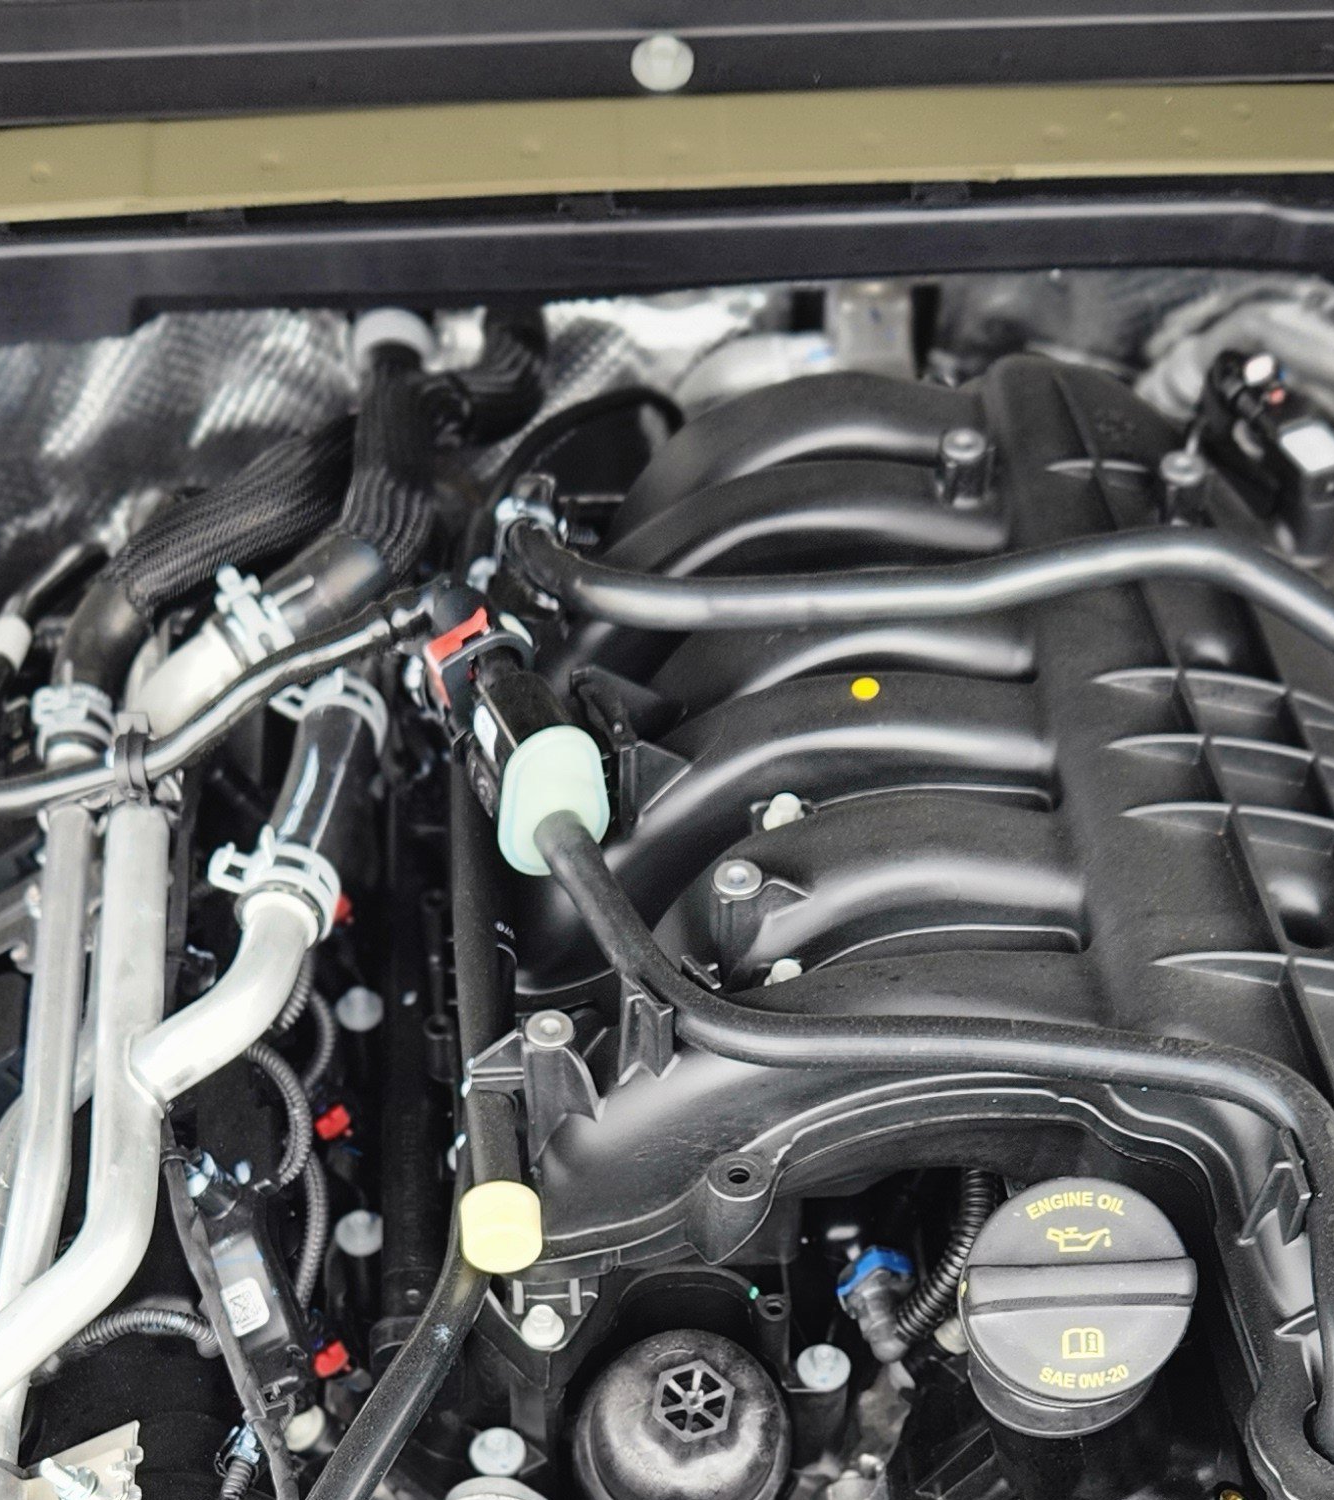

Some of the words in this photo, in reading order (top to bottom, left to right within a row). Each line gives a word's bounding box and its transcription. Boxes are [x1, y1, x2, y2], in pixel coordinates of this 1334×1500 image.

[1025, 1191, 1093, 1221] ENGINE
[1097, 1193, 1125, 1216] OIL
[1038, 1367, 1076, 1389] SAE
[1078, 1363, 1130, 1388] 0W-20
